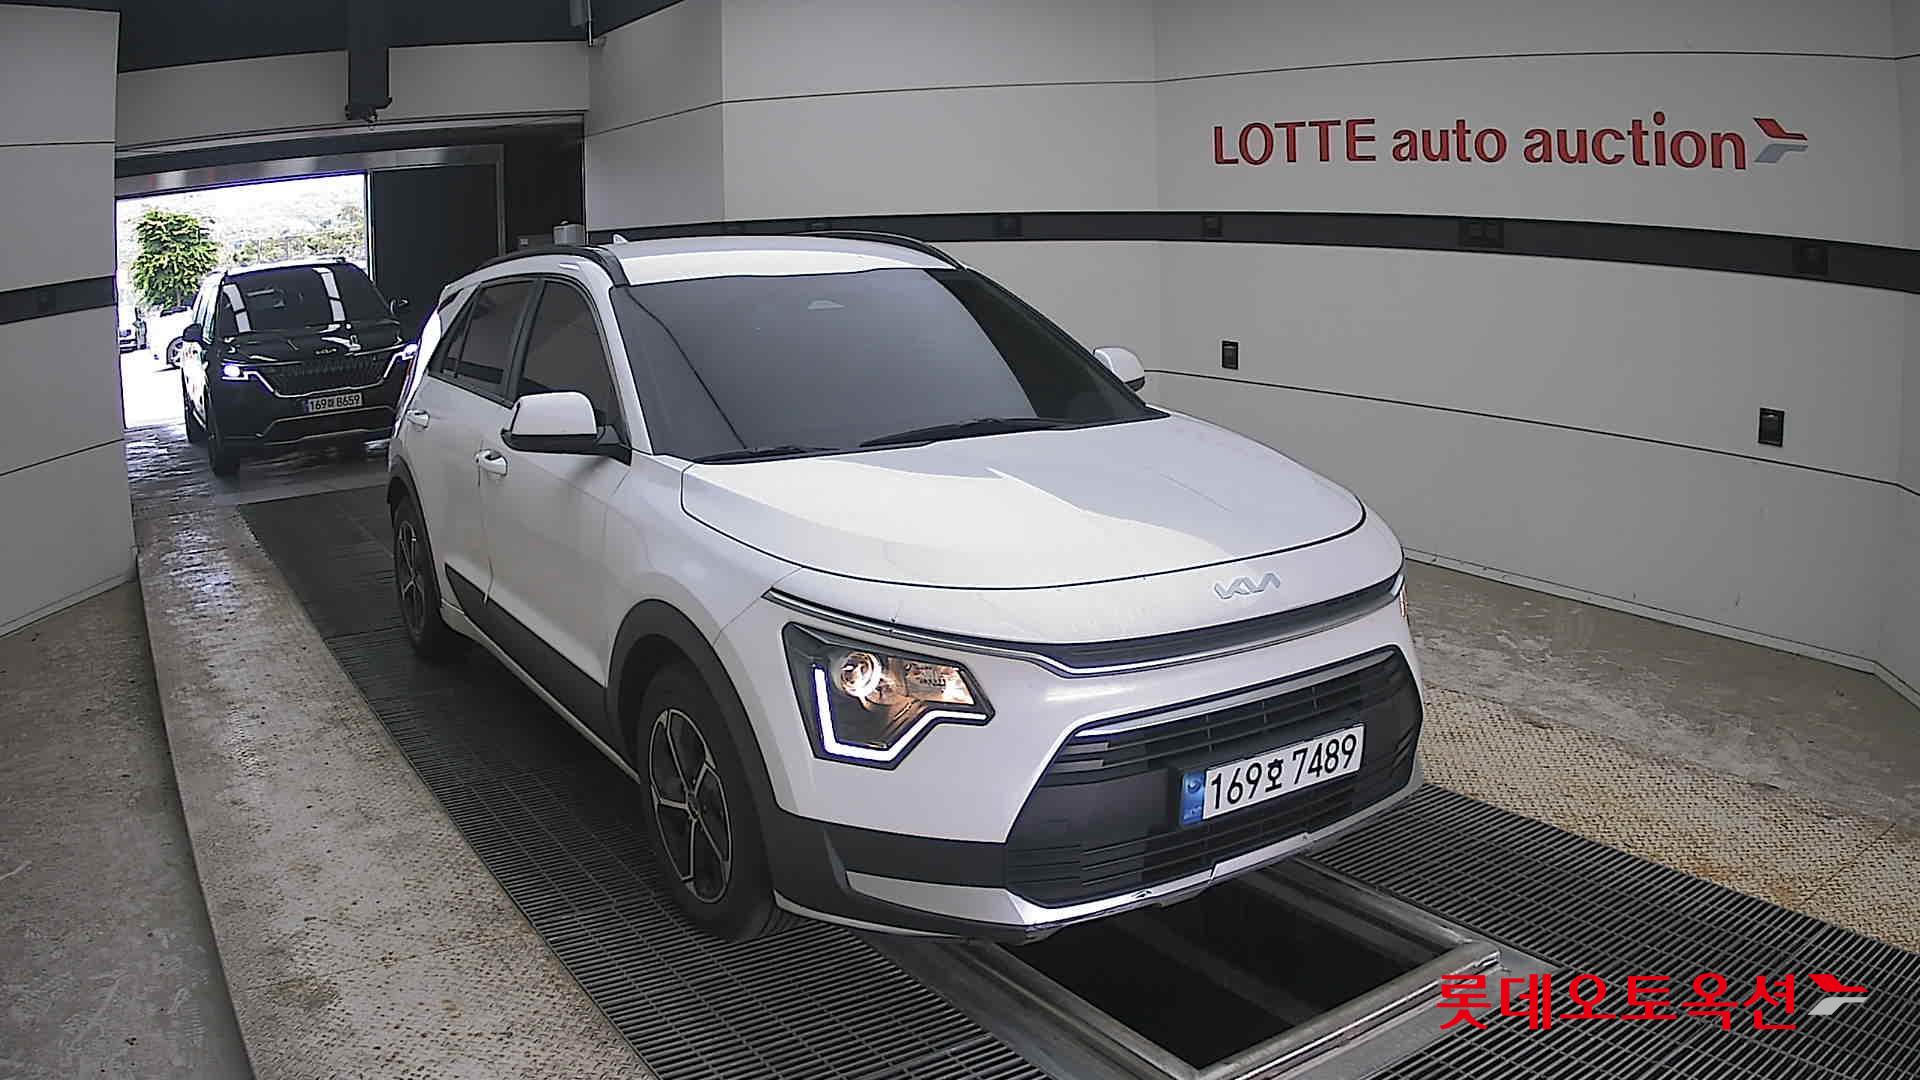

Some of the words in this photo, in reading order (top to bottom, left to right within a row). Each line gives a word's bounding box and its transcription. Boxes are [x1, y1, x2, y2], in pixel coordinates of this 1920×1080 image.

[1213, 119, 1377, 165] LOTTE
[1392, 118, 1508, 162] auto
[1523, 111, 1747, 170] auction
[1210, 758, 1285, 809] 169호
[1291, 734, 1357, 785] 7489
